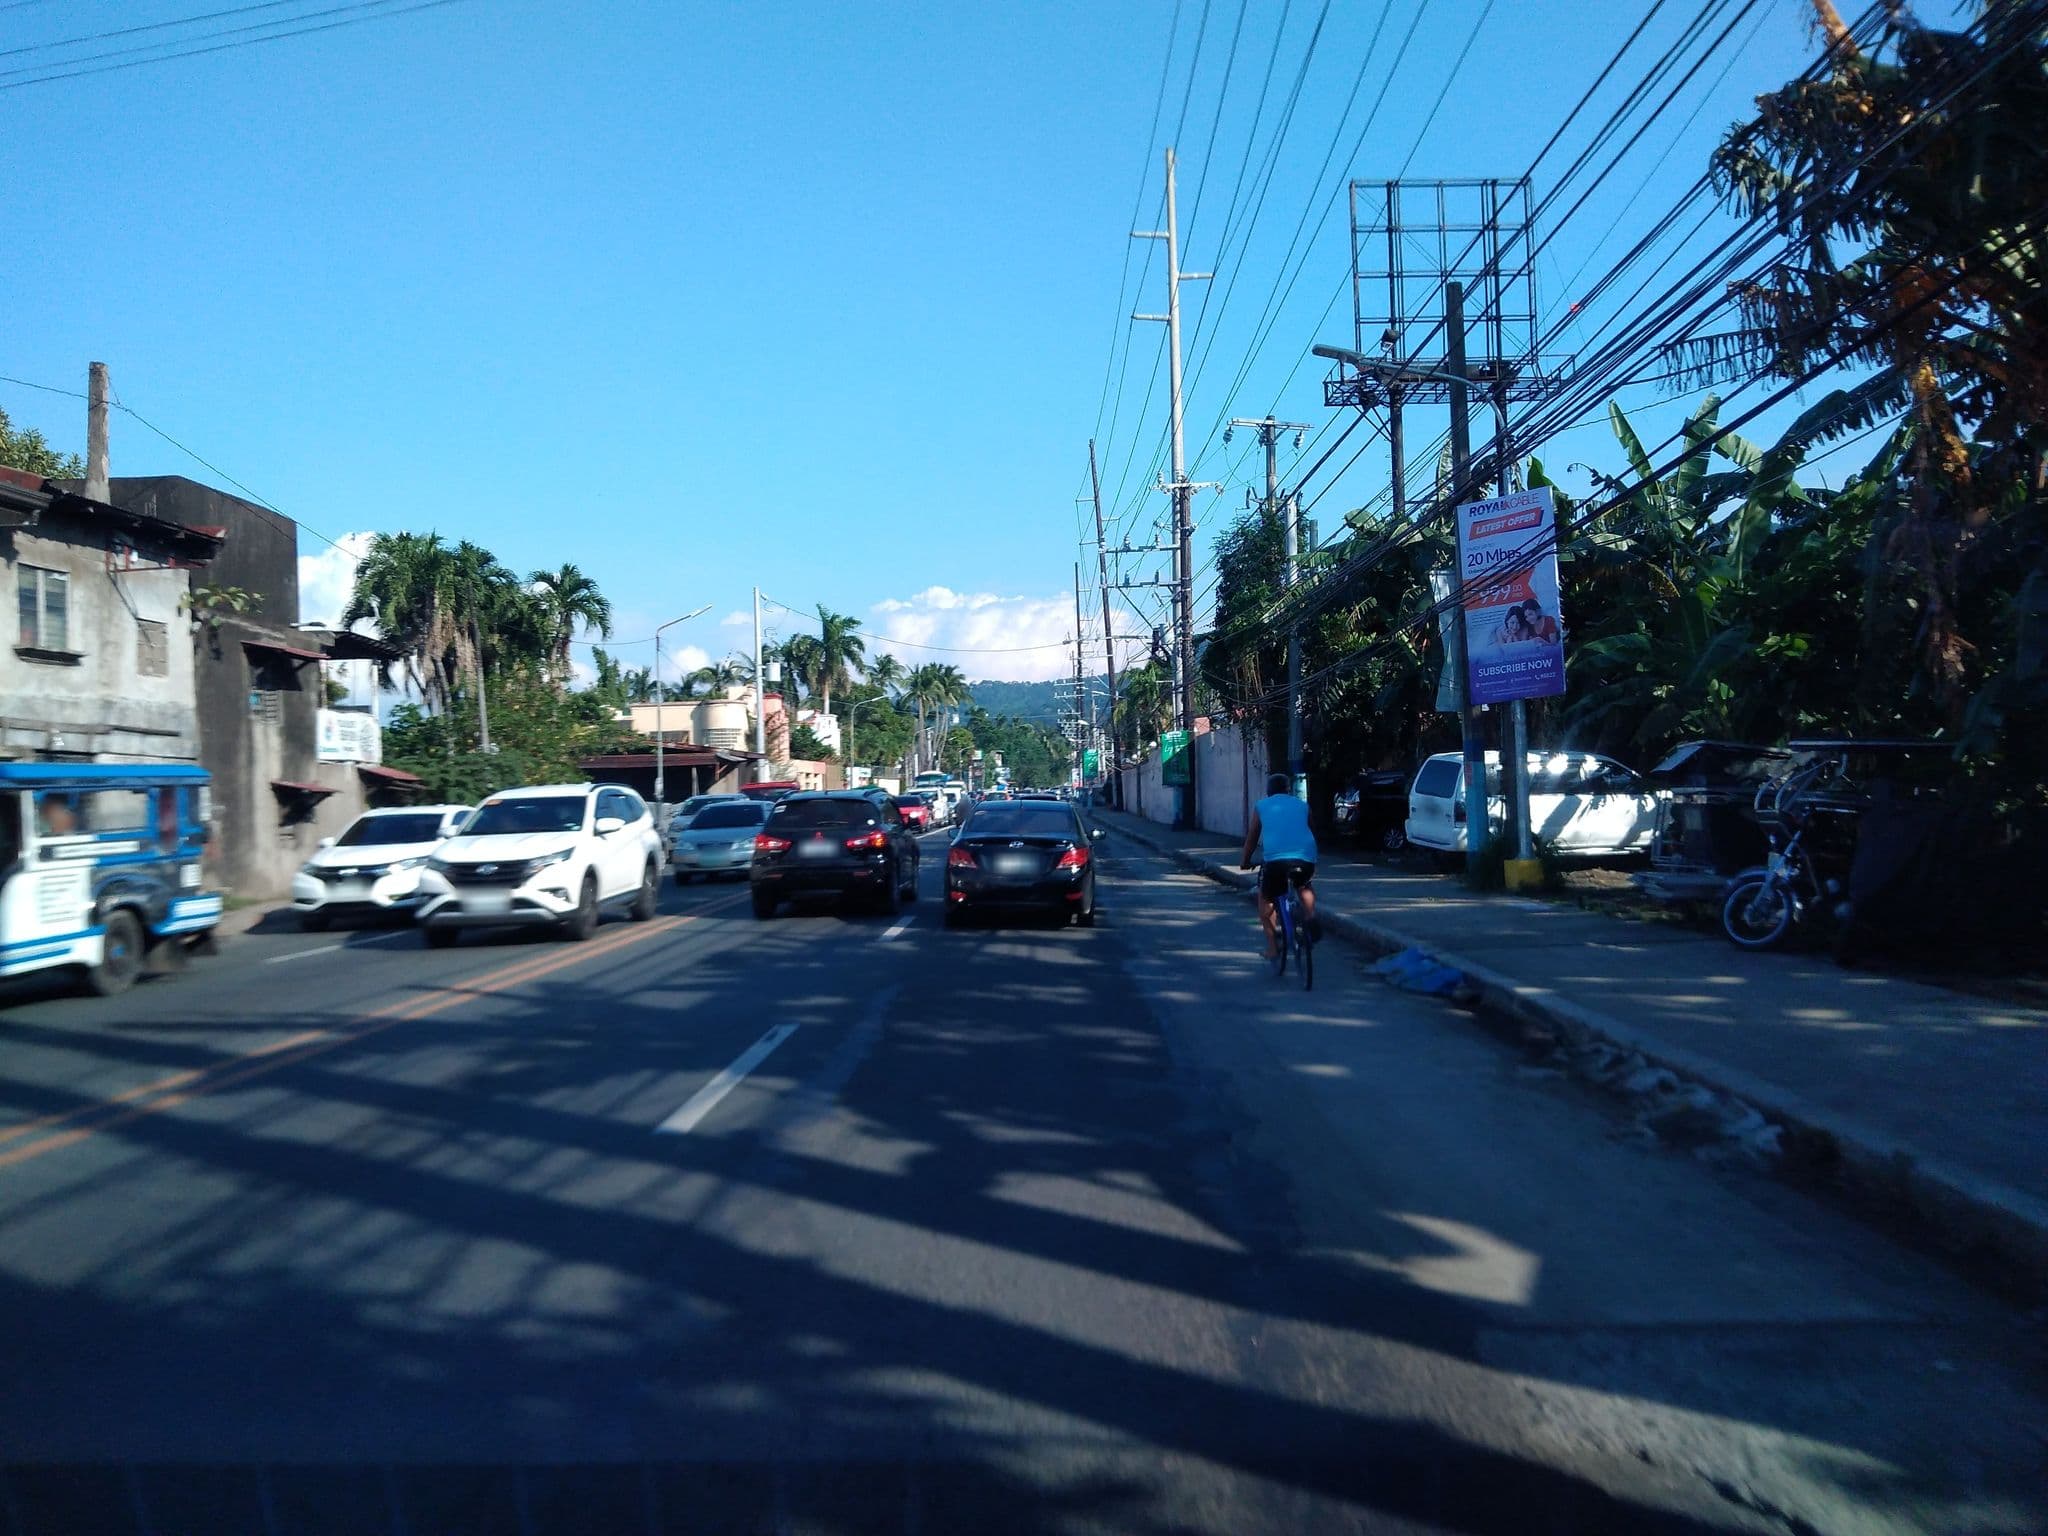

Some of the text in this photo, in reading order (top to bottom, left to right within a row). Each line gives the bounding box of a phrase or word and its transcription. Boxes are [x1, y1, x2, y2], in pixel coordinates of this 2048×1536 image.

[1476, 512, 1536, 534] LATEST OFFER
[1467, 548, 1521, 567] 20 Mbps
[1478, 662, 1527, 677] SUBSCRIBE
[1527, 658, 1553, 670] NOW
